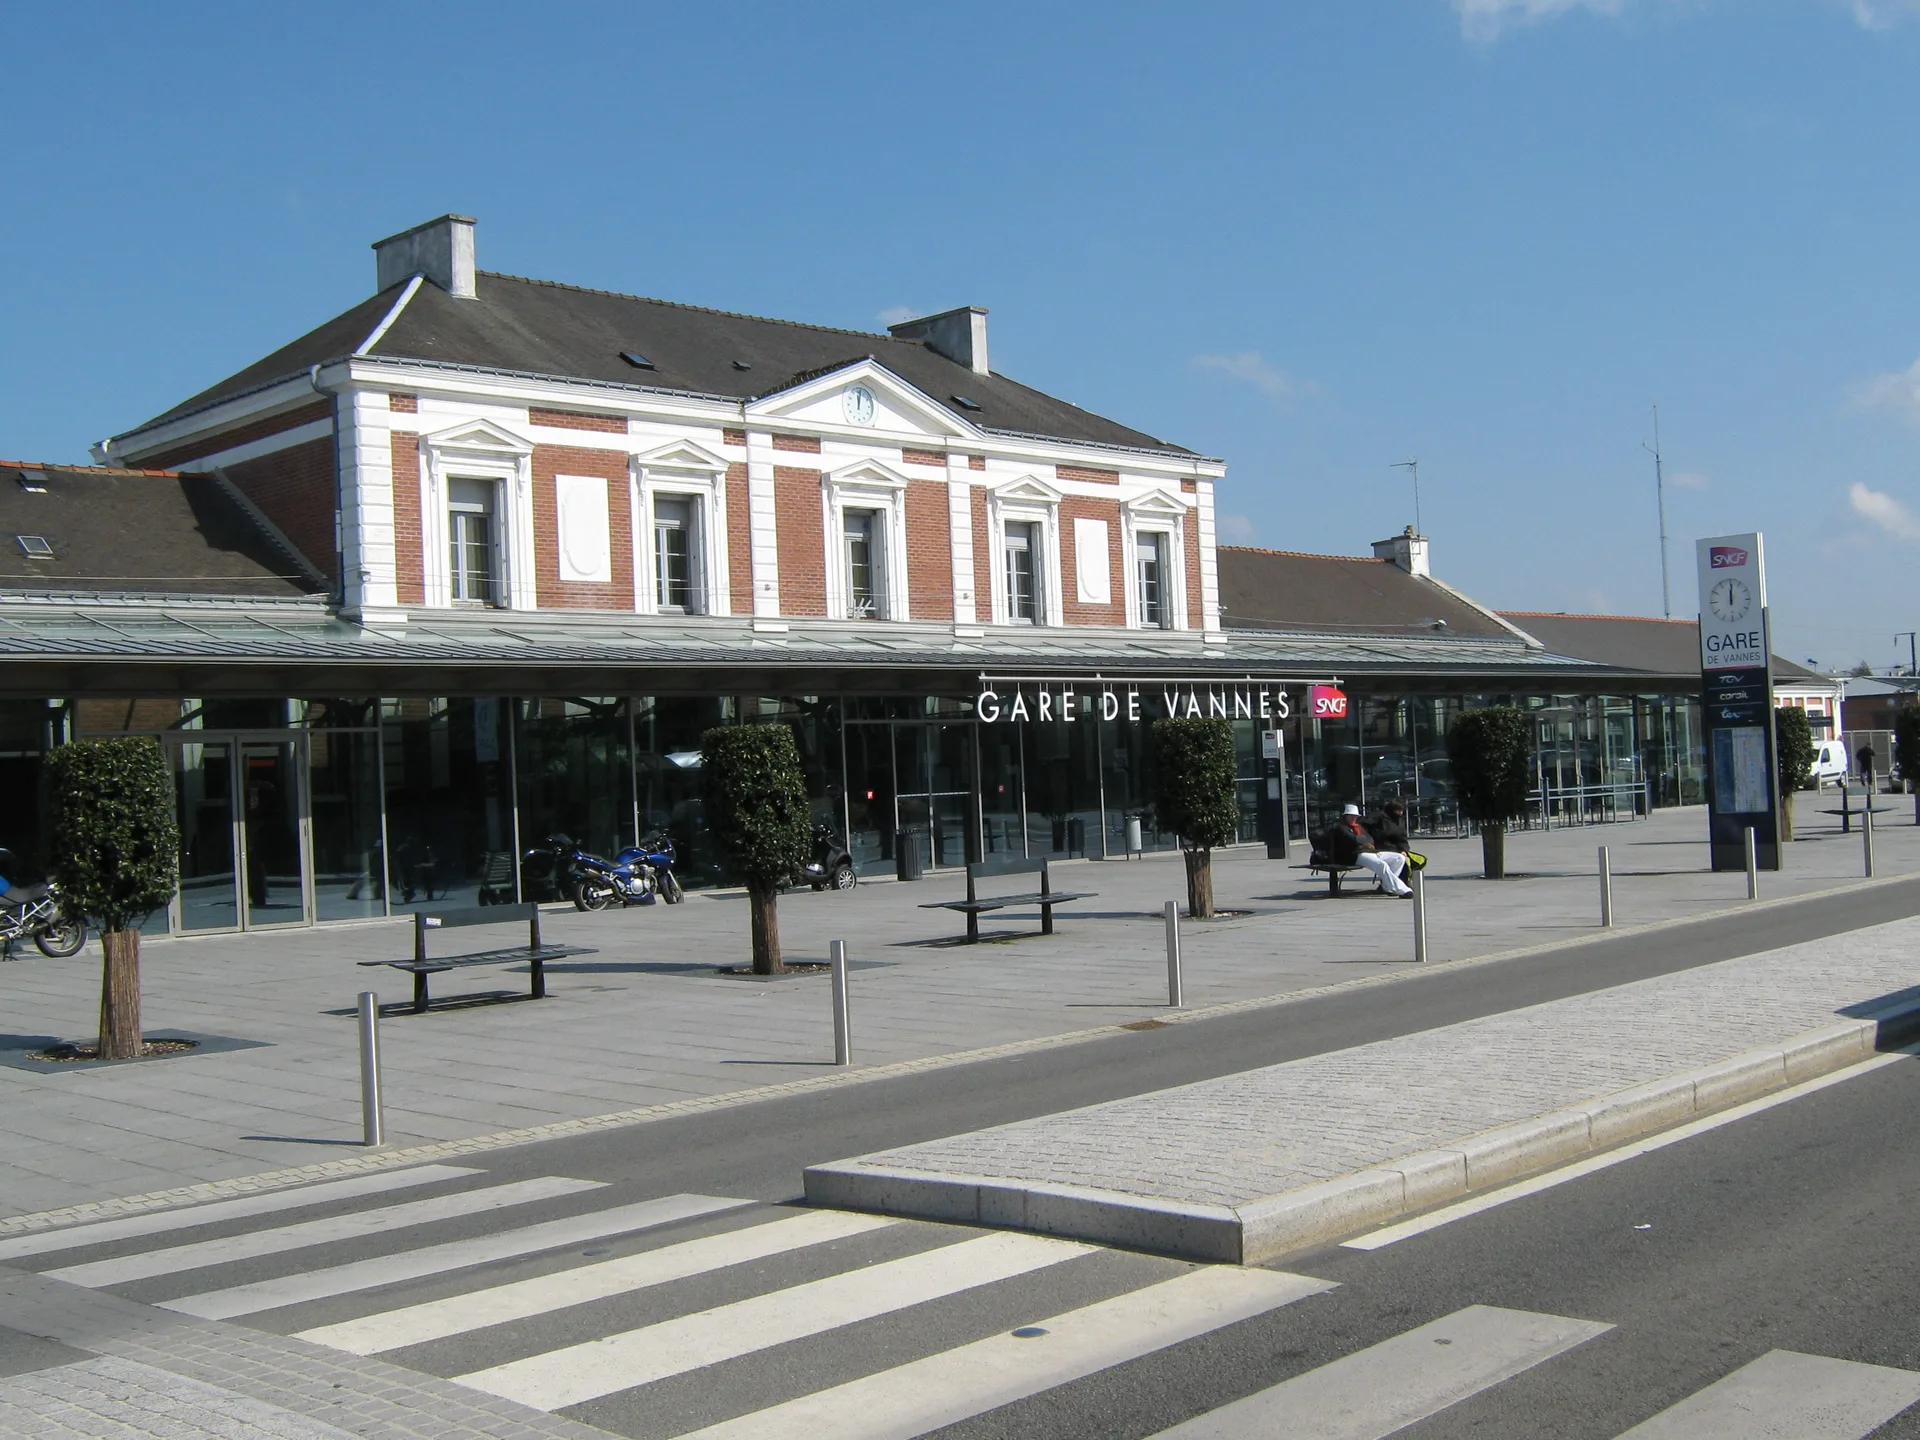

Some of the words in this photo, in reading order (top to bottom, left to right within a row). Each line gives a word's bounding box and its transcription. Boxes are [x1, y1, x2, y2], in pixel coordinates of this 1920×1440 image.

[1713, 552, 1746, 566] SNCF
[1706, 631, 1760, 652] GARE
[1707, 655, 1719, 664] DE
[1723, 652, 1761, 663] VANNES
[977, 691, 1076, 723] GARE
[1102, 691, 1140, 721] DE
[1163, 691, 1290, 719] VANNES
[1315, 697, 1348, 714] SNCF
